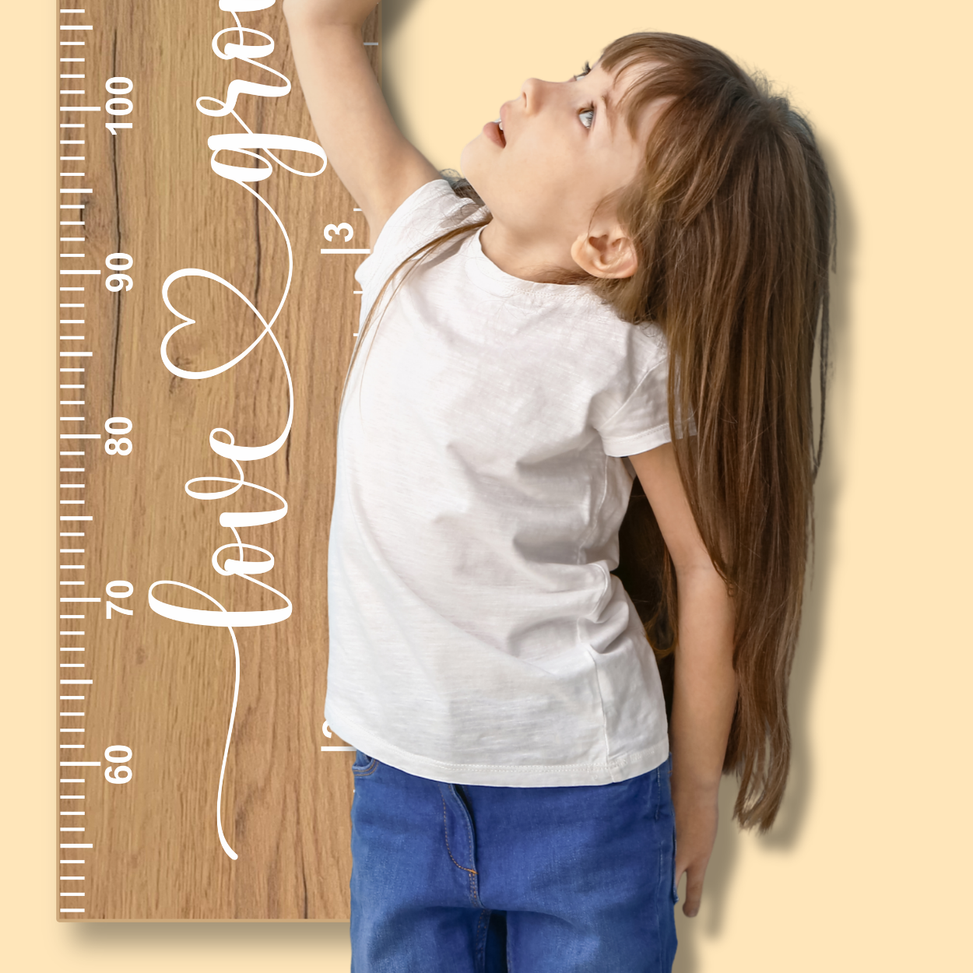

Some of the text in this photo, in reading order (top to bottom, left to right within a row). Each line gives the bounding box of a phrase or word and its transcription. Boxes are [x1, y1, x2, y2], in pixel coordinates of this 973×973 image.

[105, 76, 134, 135] 100
[323, 222, 354, 243] 3
[105, 252, 134, 292] 90
[104, 416, 133, 456] 80
[148, 427, 293, 628] love
[105, 580, 134, 620] 70
[104, 745, 133, 784] 60
